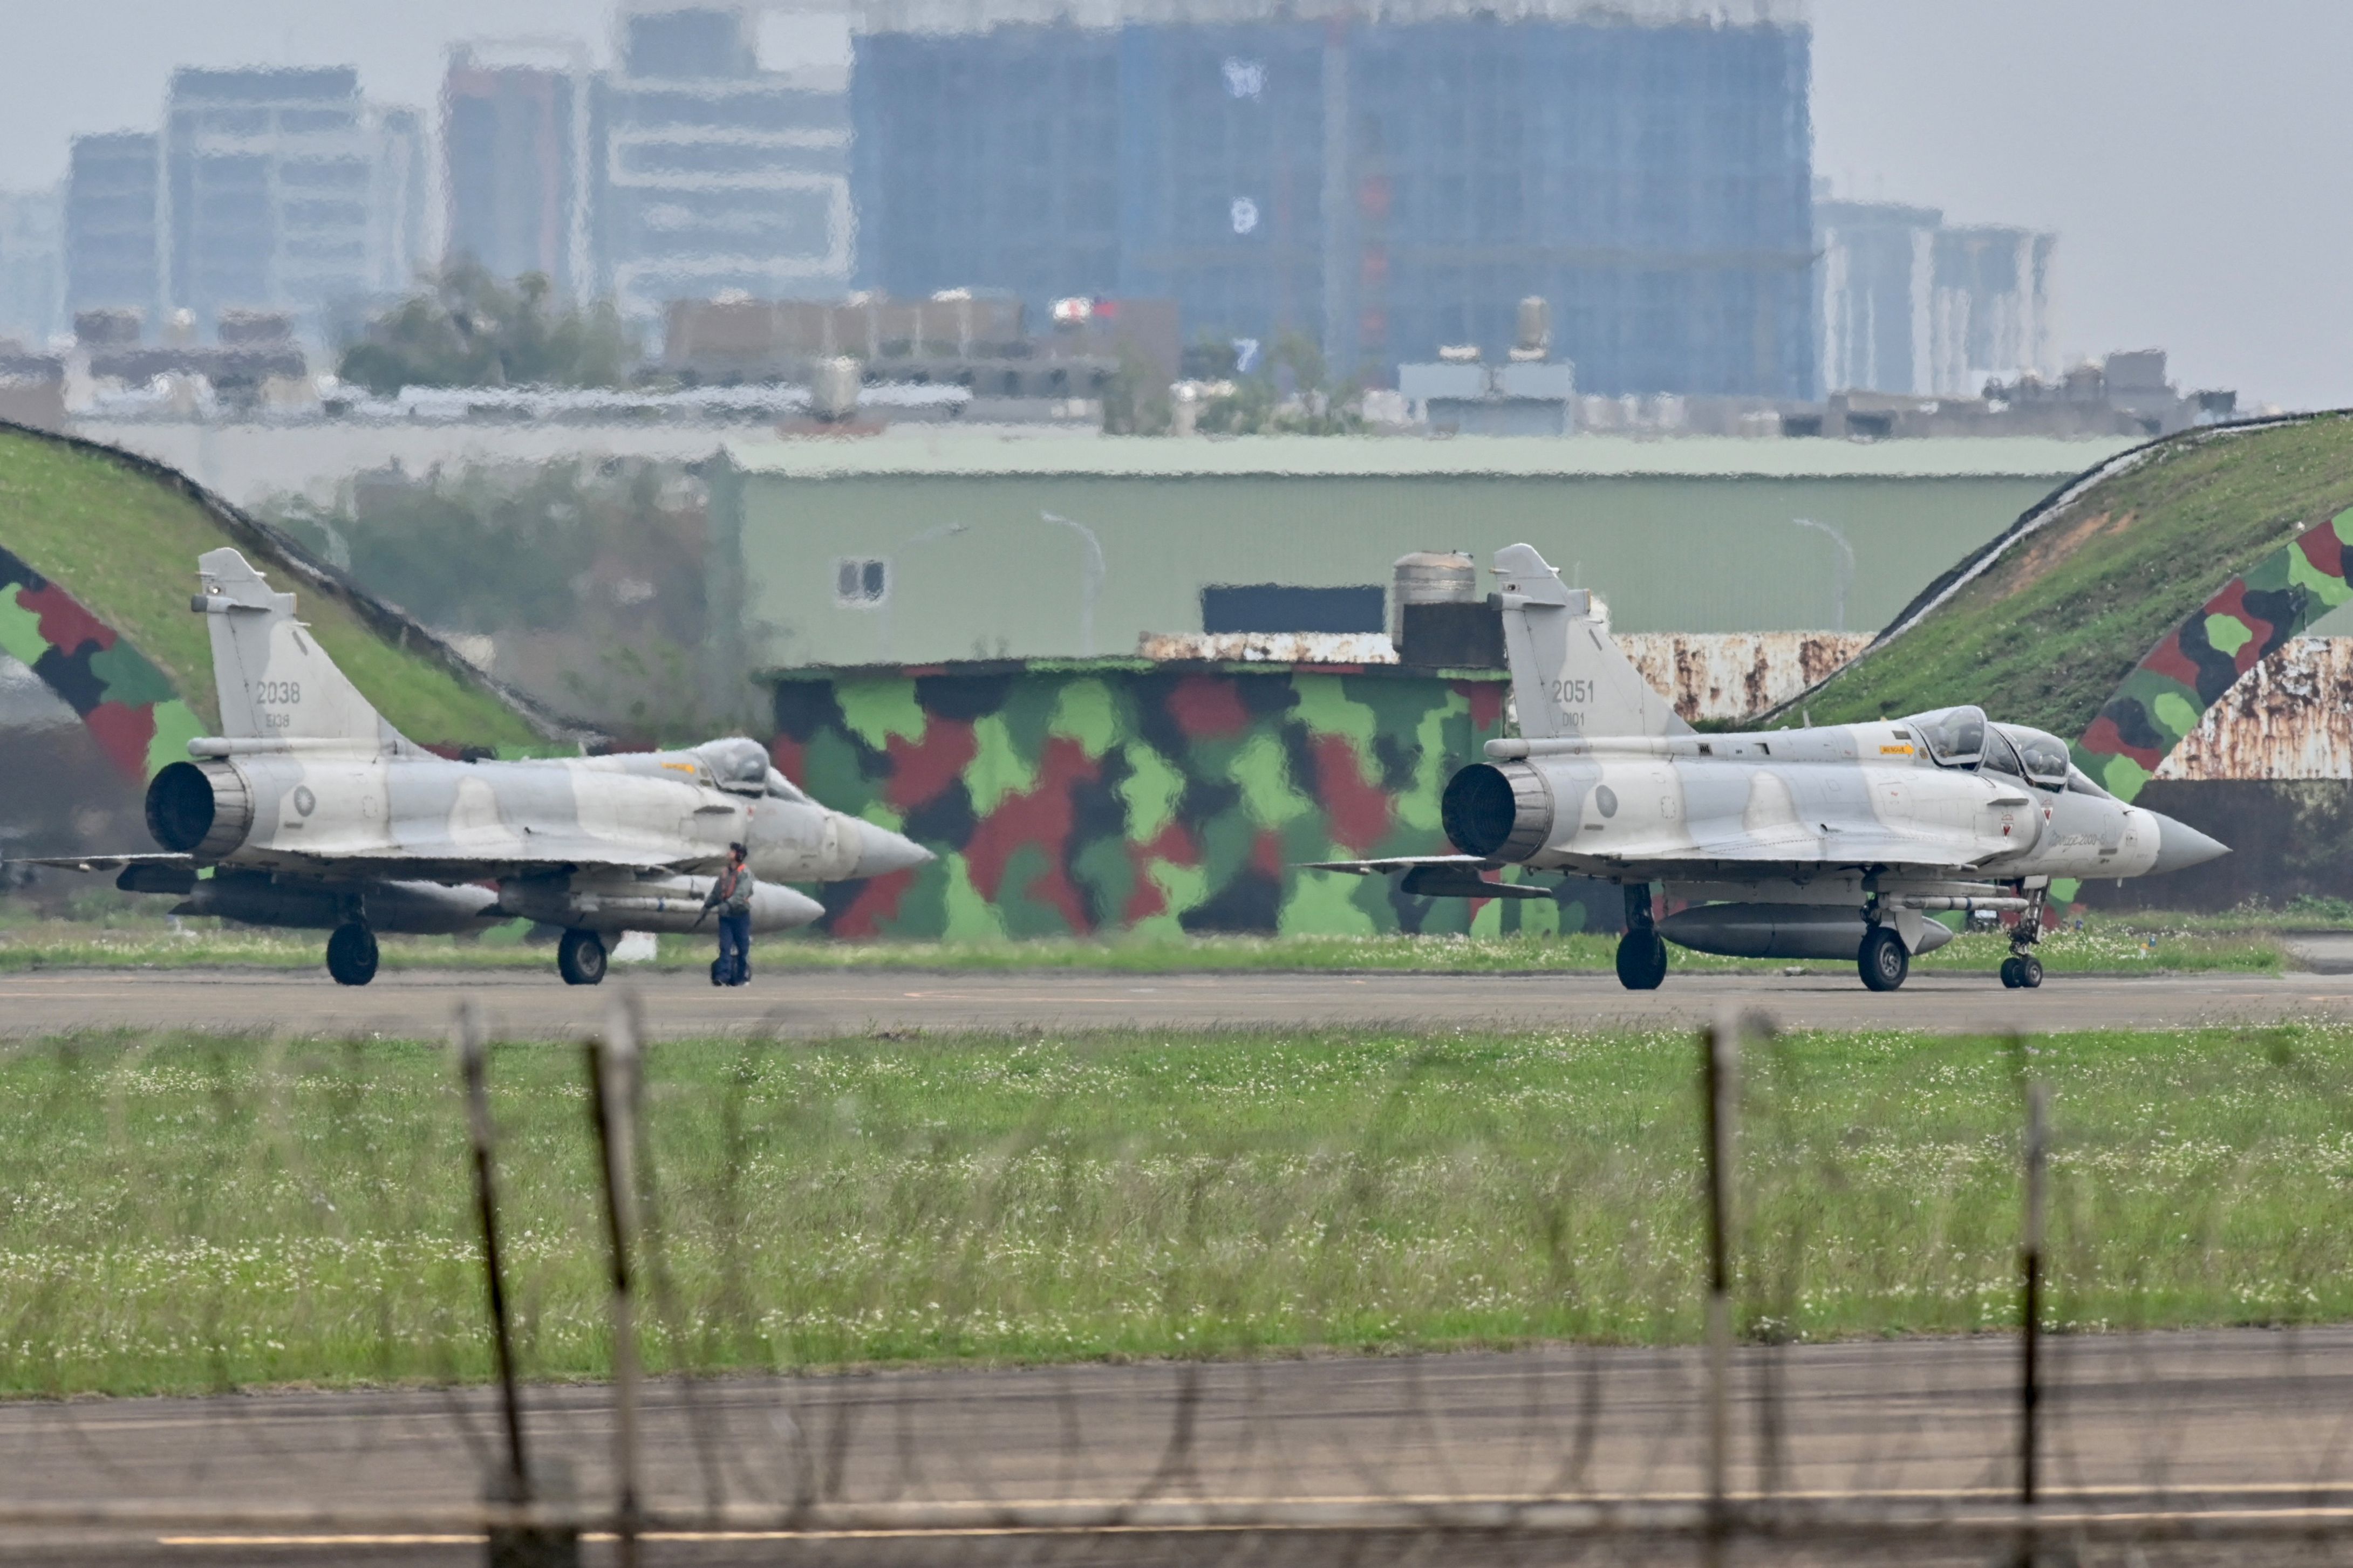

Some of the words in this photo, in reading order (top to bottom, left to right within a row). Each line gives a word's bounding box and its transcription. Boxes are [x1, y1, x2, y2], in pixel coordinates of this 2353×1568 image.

[1232, 338, 1259, 372] 7
[256, 681, 300, 704] 2038
[1552, 680, 1593, 703] 2051
